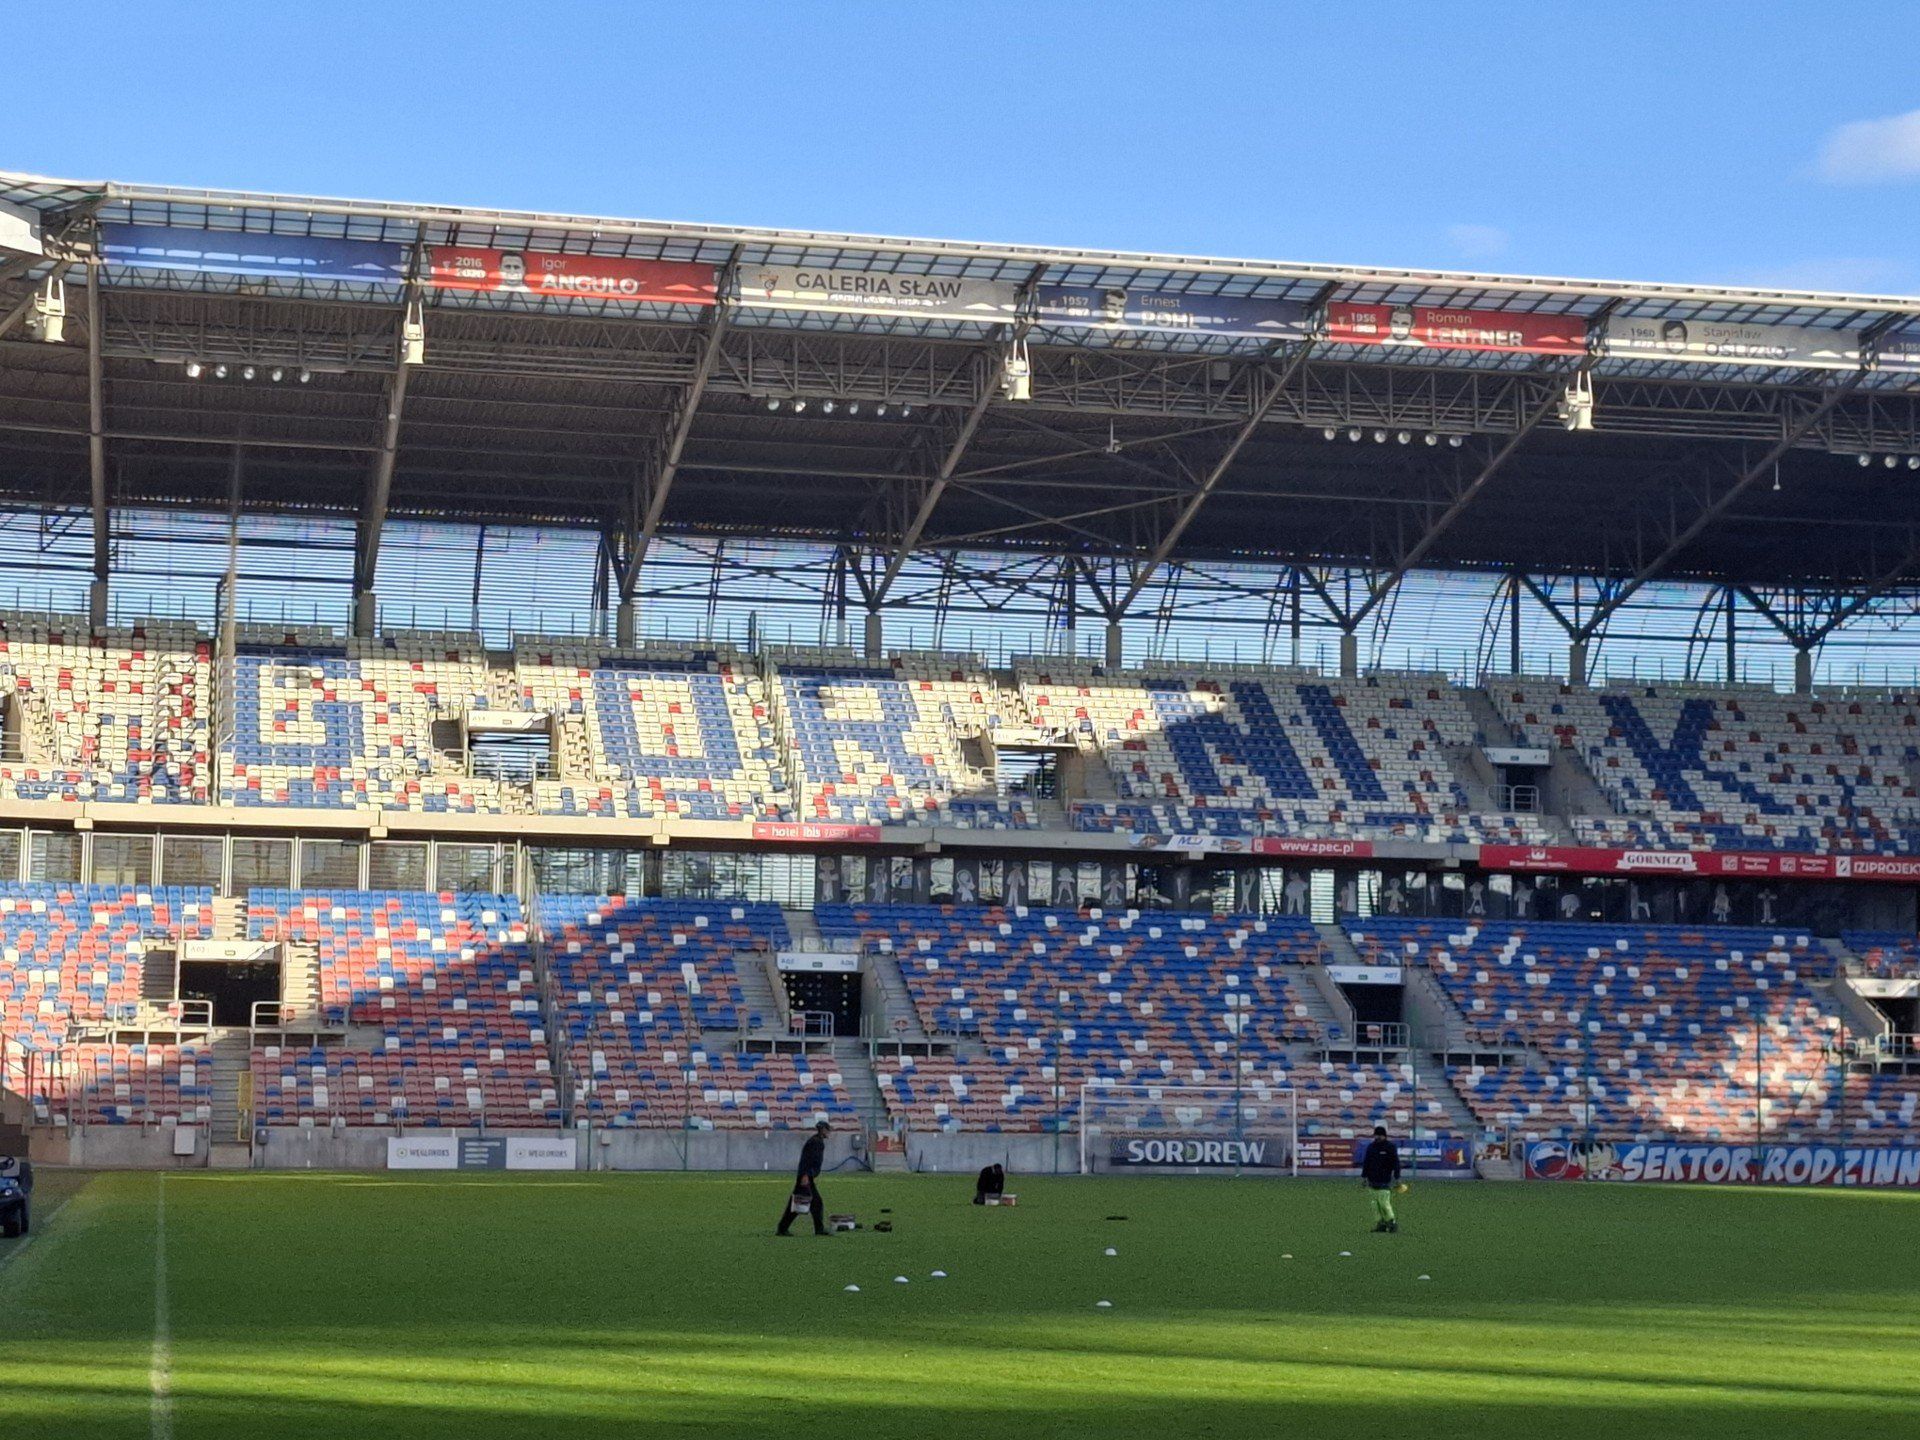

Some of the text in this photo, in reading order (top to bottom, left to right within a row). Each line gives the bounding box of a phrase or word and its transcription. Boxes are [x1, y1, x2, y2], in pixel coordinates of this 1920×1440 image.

[456, 257, 483, 267] 2016
[541, 256, 567, 270] Igor
[540, 274, 639, 295] ANGULO
[795, 272, 893, 295] GALERIA
[899, 280, 962, 299] SŁAW
[1140, 295, 1181, 308] Ernest
[1426, 312, 1473, 325] Roman
[1426, 327, 1523, 346] LENTNER
[771, 825, 799, 838] hotel
[1280, 841, 1355, 854] www.zpec.pl
[1621, 1144, 1754, 1183] SEKTOR
